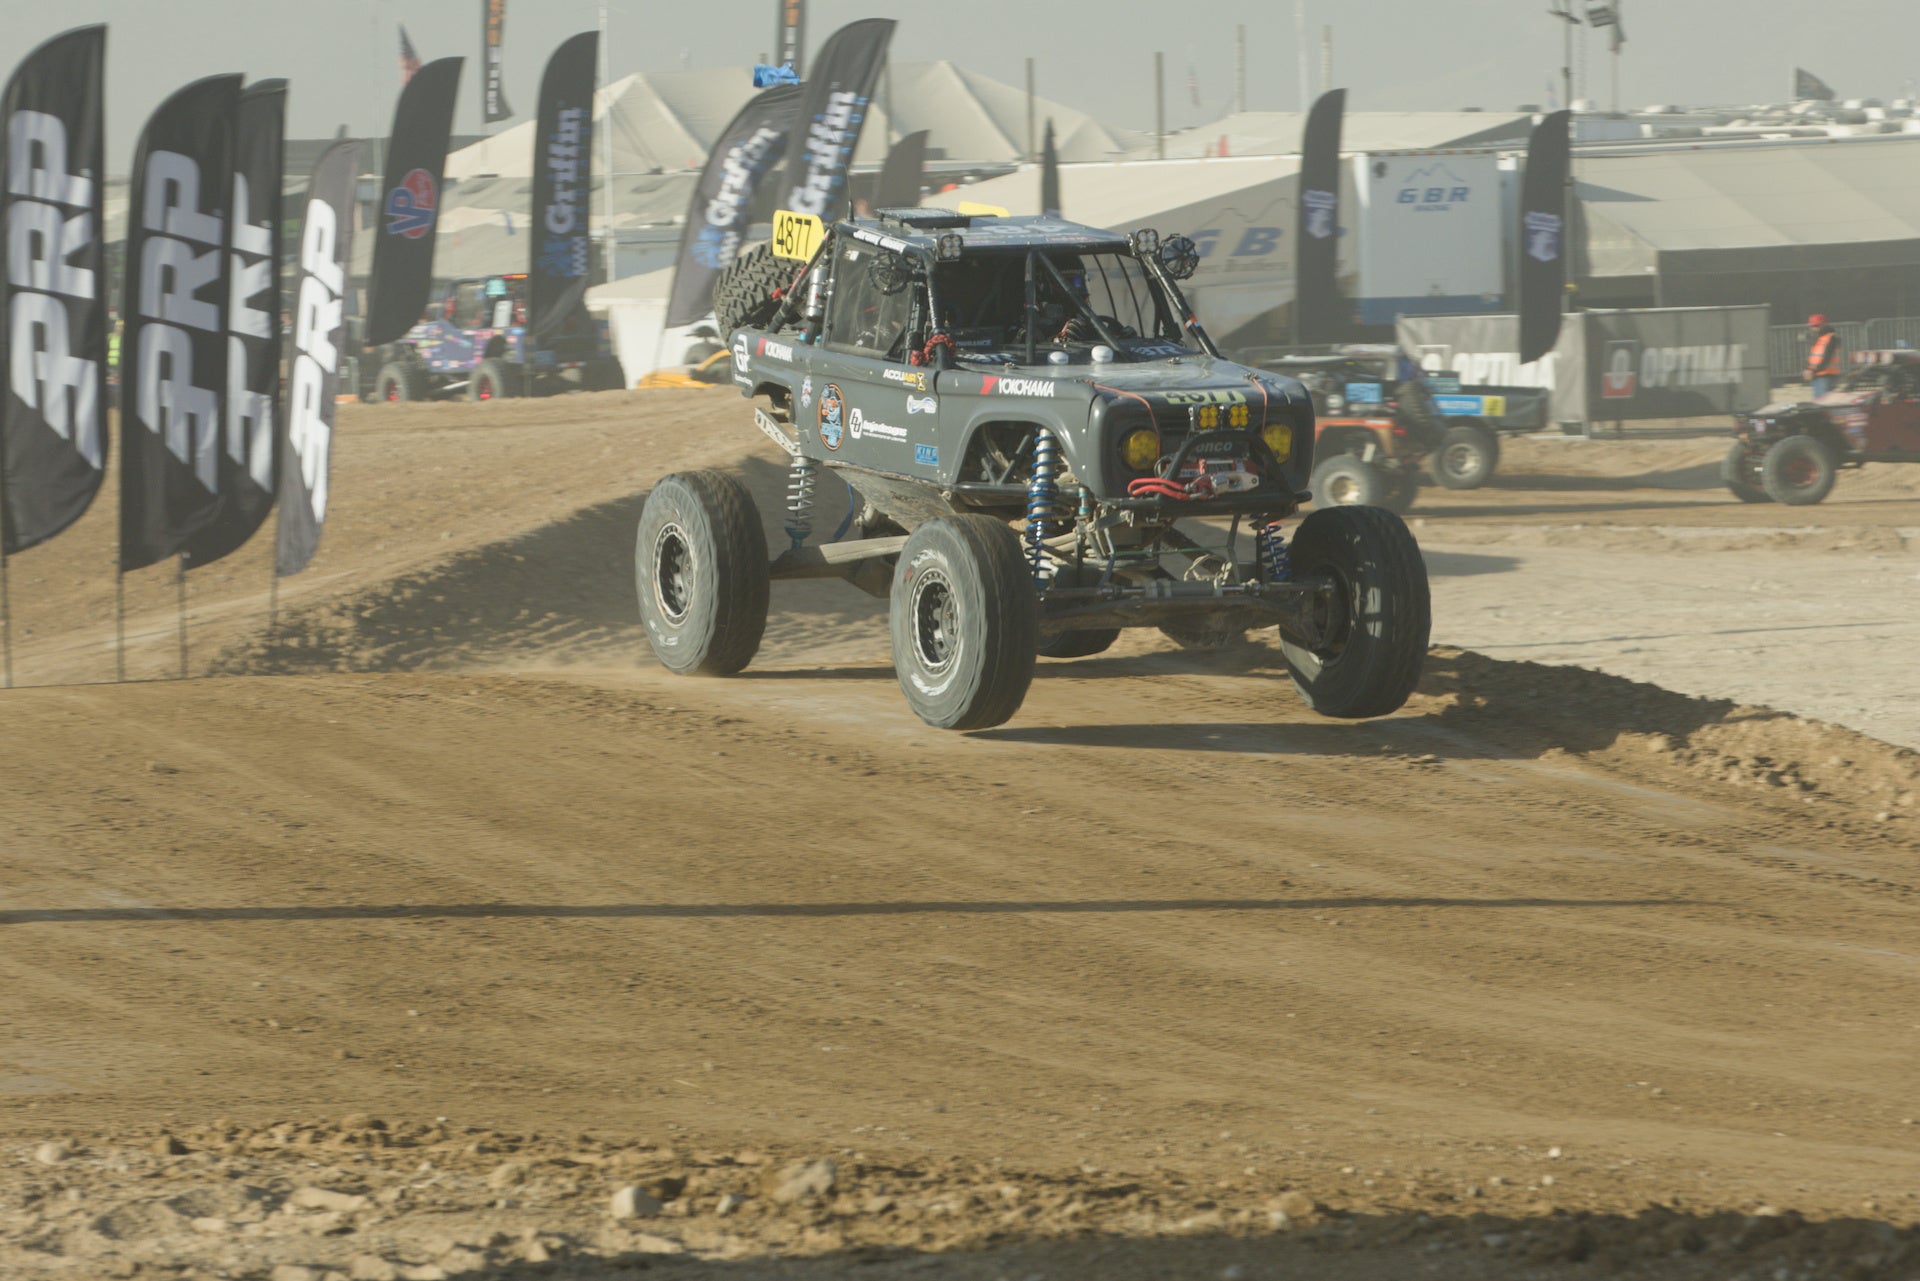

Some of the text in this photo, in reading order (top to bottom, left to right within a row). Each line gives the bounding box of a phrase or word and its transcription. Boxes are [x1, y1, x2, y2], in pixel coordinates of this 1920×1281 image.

[384, 186, 436, 236] VP
[545, 106, 582, 235] Griffin
[776, 214, 812, 258] 4877
[9, 110, 102, 470] PRP
[136, 150, 222, 494] PRP
[289, 199, 344, 523] PRP
[998, 378, 1055, 397] YOKOHAMA
[1640, 344, 1749, 388] OPTIMA
